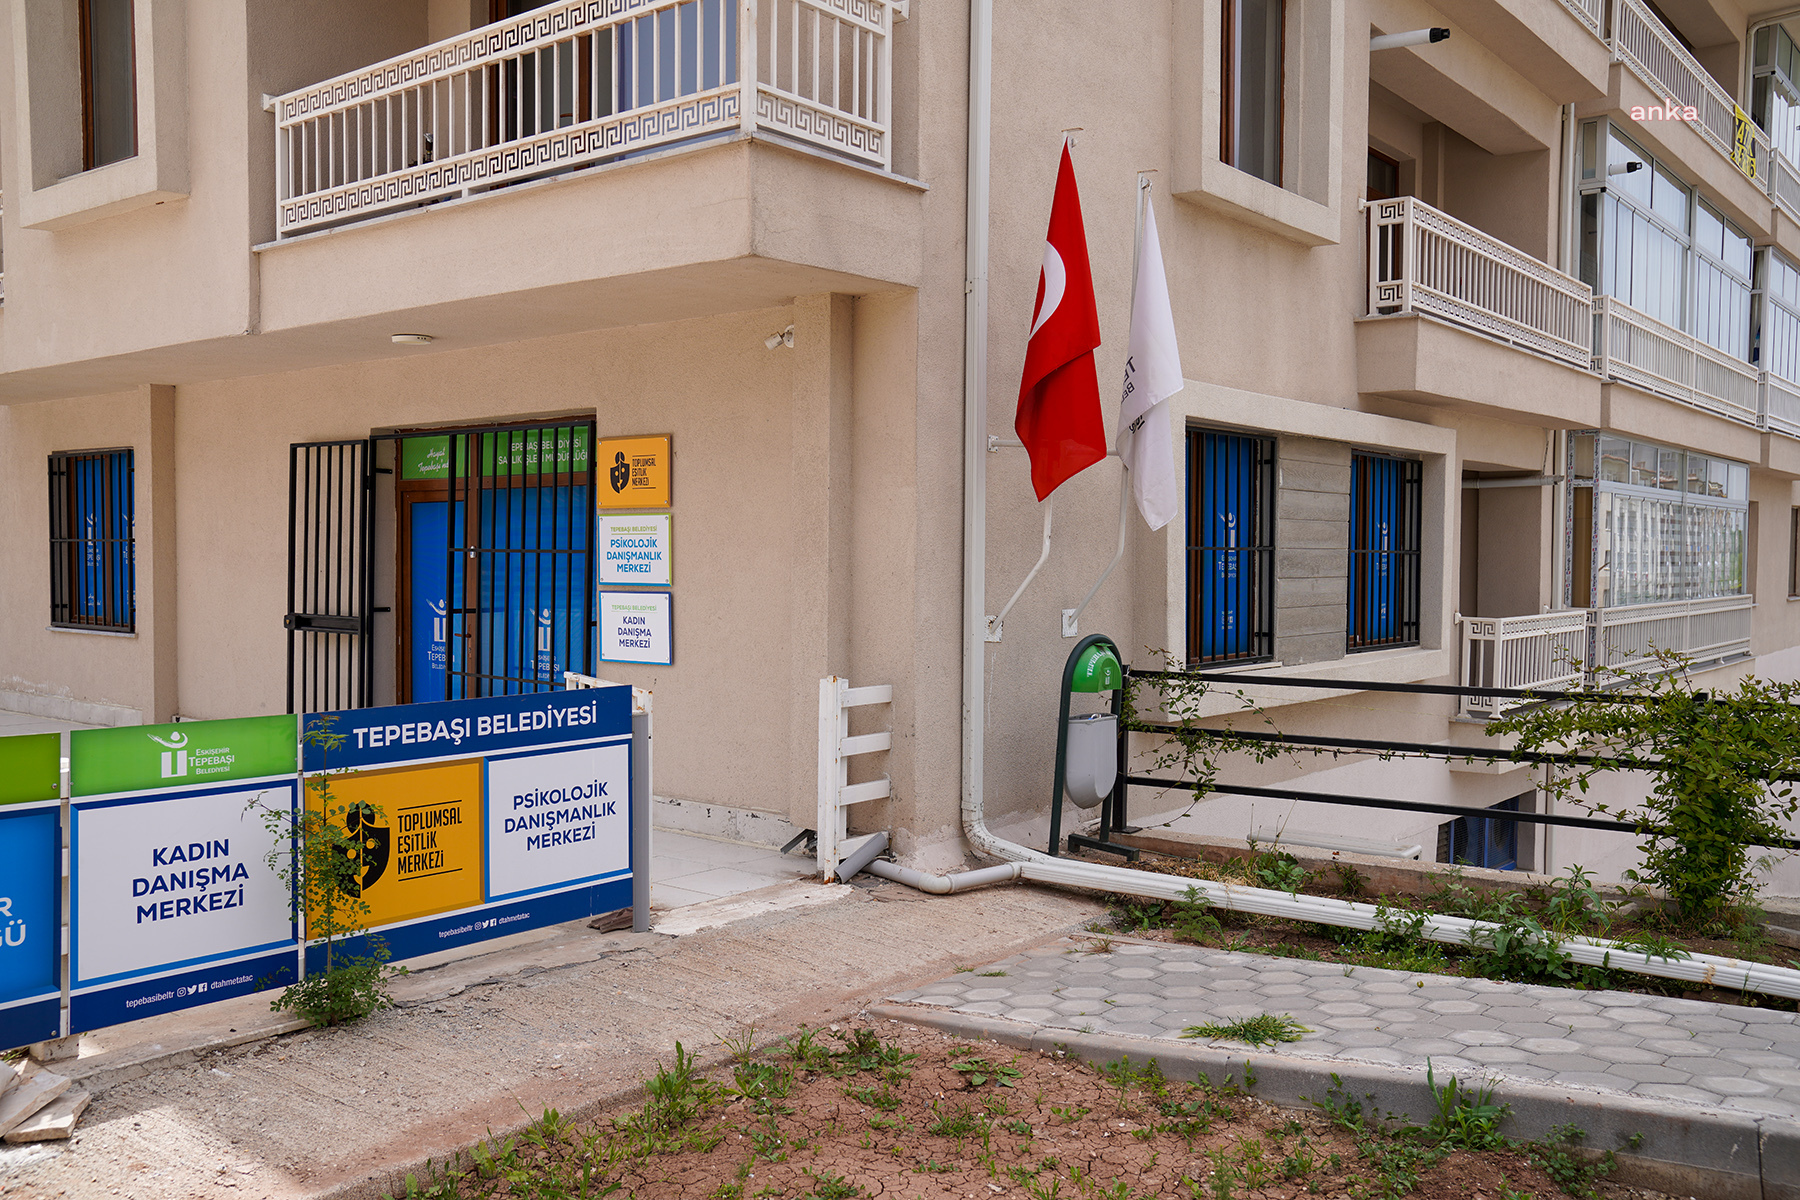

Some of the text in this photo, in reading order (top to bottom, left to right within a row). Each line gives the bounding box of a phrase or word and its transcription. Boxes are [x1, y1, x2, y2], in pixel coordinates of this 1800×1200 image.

[498, 454, 522, 465] SALIK
[610, 536, 658, 548] PSİKOLOJİK
[606, 551, 662, 563] DANIŞMANLIK
[616, 561, 651, 573] MERKEZİ
[611, 604, 631, 612] TEPEBAŞI
[622, 616, 646, 625] KADIN
[617, 627, 652, 639] DANIŞMA
[618, 638, 651, 648] MERKEZİ
[353, 700, 597, 749] TEPEBAŞI BELEDİYESİ
[188, 754, 235, 768] TEPEBAŞI
[195, 747, 230, 757] ESKİŞEHİR
[195, 765, 230, 775] BELEDİYESİ
[513, 779, 608, 811] PSİKOLOJİK
[398, 806, 462, 833] TOPLUMSAL
[504, 801, 617, 834] DANIŞMANLIK
[398, 831, 437, 854] EŞİTLİK
[526, 821, 596, 852] MERKEZİ
[152, 838, 229, 867] KADIN
[398, 850, 444, 875] MERKEZİ
[132, 862, 249, 898] DANIŞMA
[136, 883, 244, 924] MERKEZİ
[0, 919, 26, 947] Ü
[126, 974, 254, 1008] tepebasibeltr dtahmetatac
